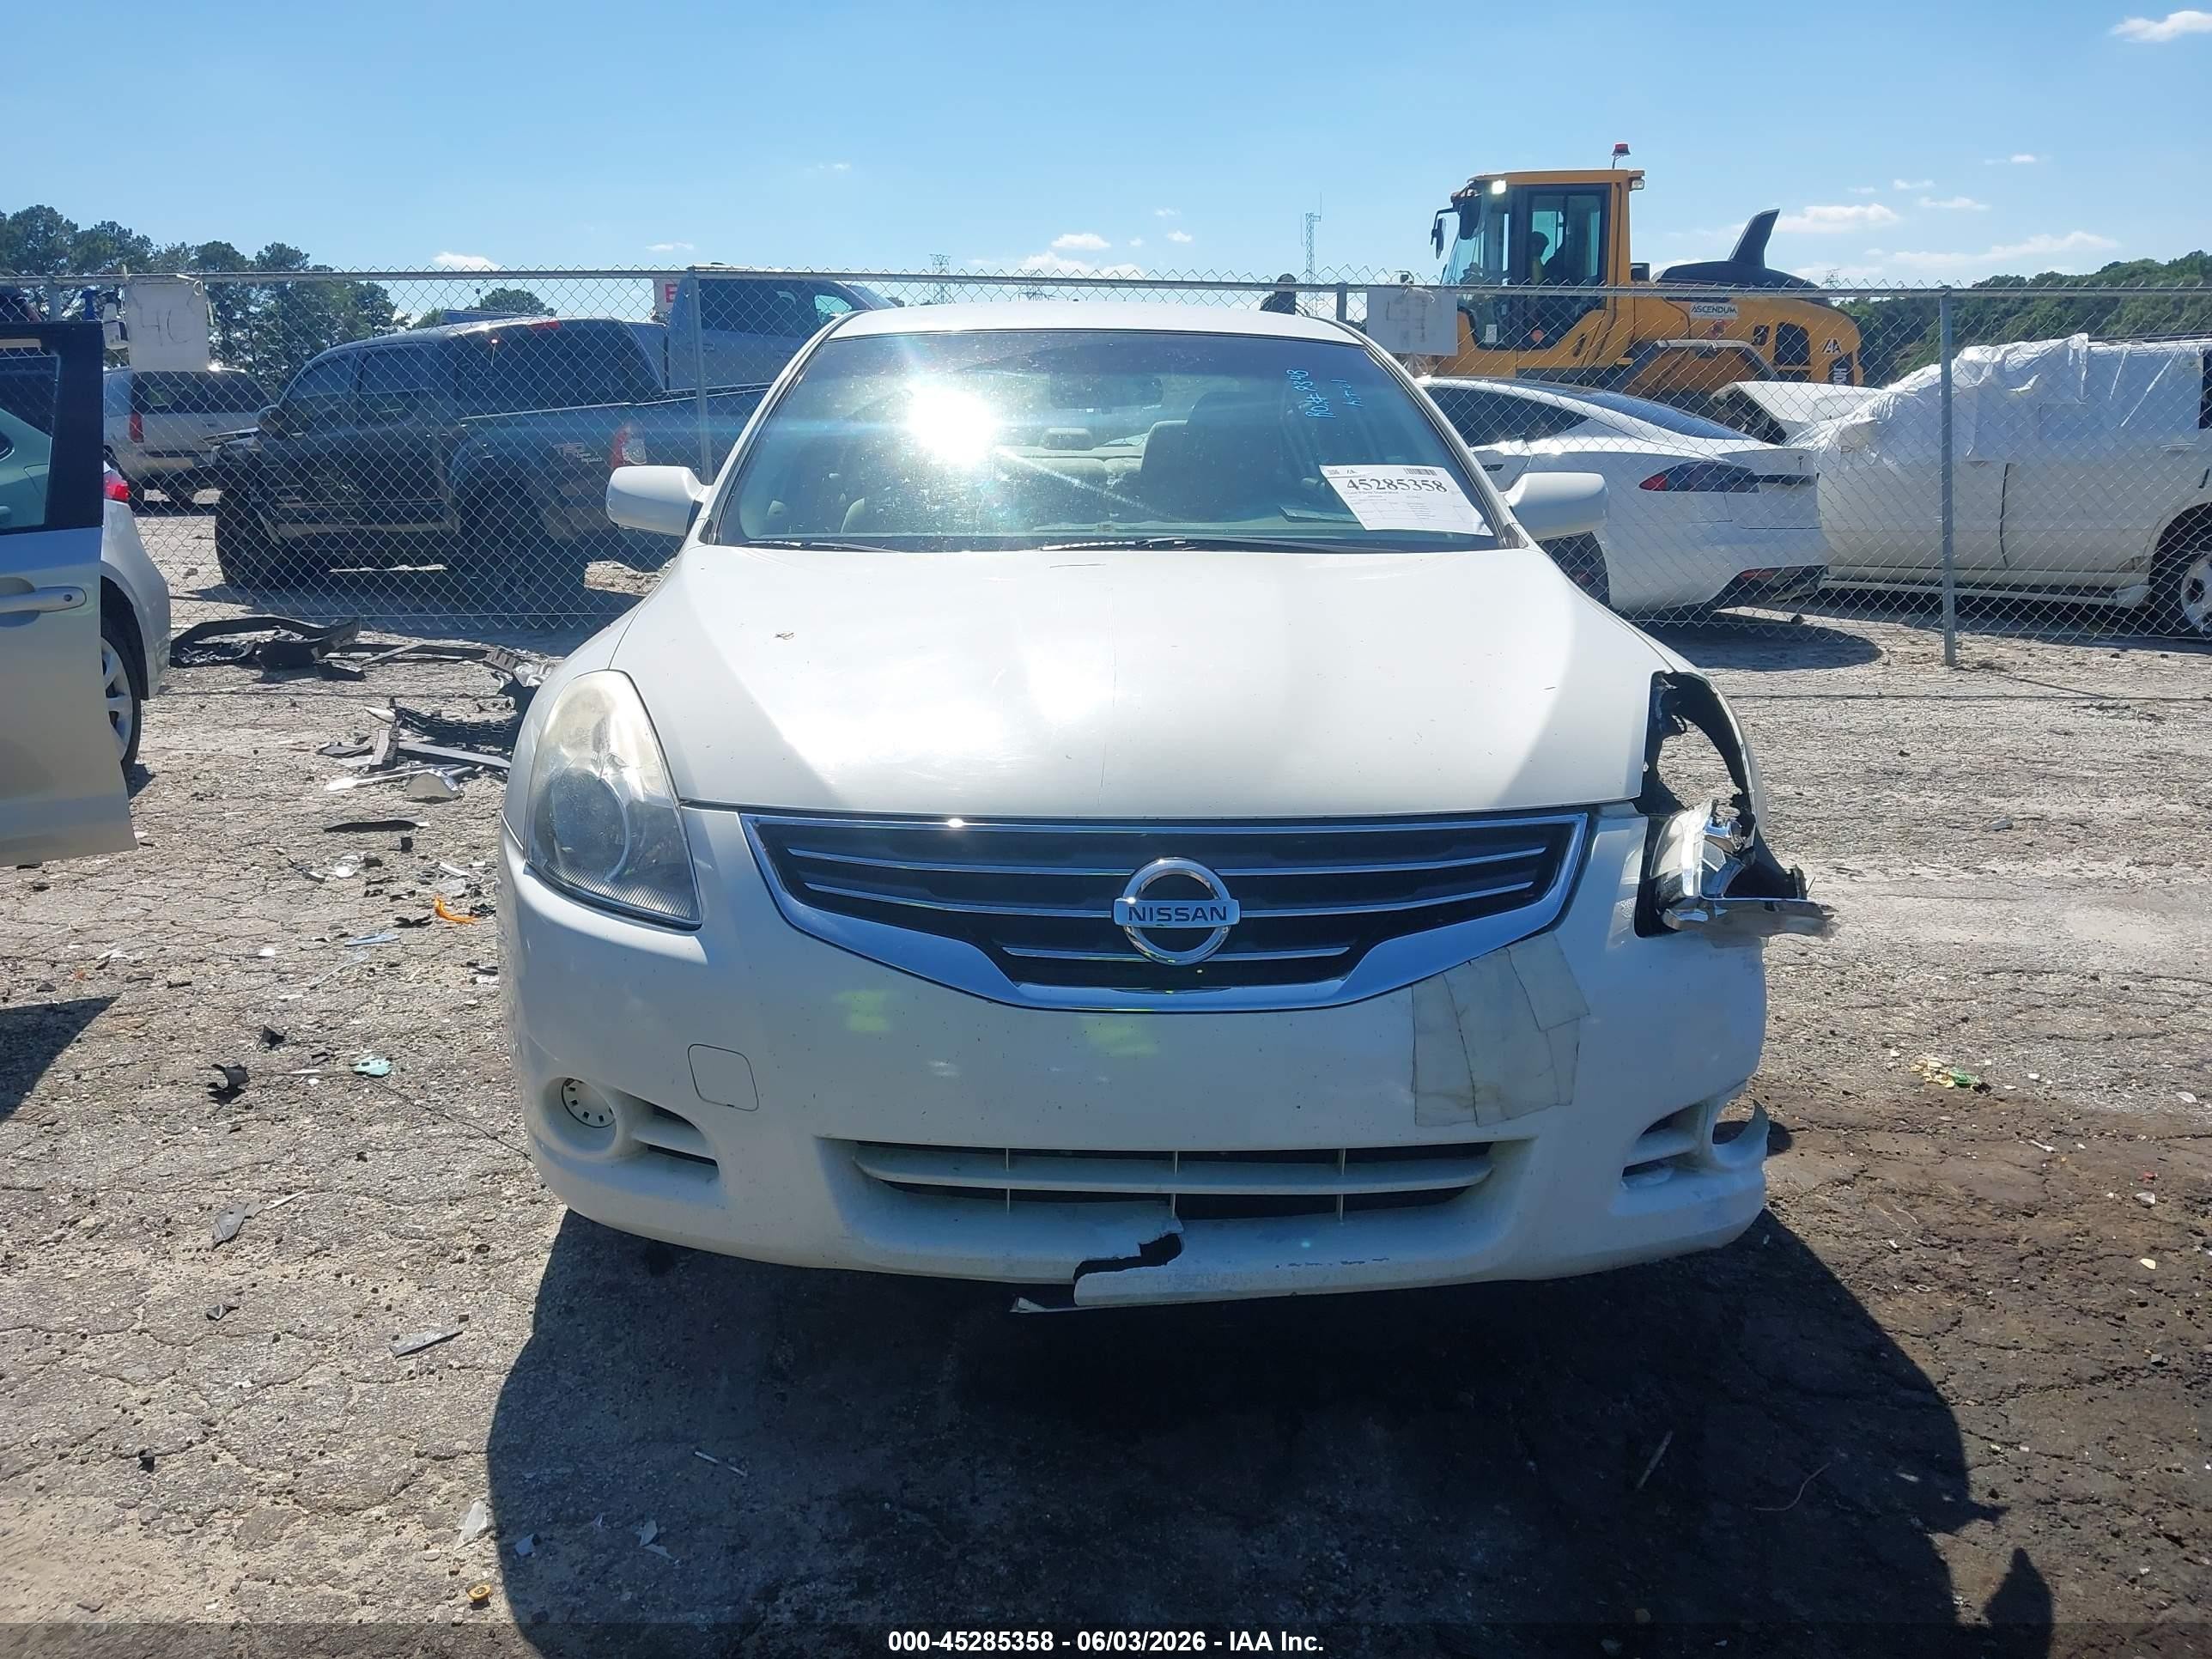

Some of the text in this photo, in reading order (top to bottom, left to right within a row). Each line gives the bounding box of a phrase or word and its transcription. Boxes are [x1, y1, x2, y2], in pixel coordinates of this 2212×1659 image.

[1691, 305, 1737, 313] ASCENDUM
[1346, 478, 1448, 494] 45285358
[1128, 906, 1227, 922] NISSAN
